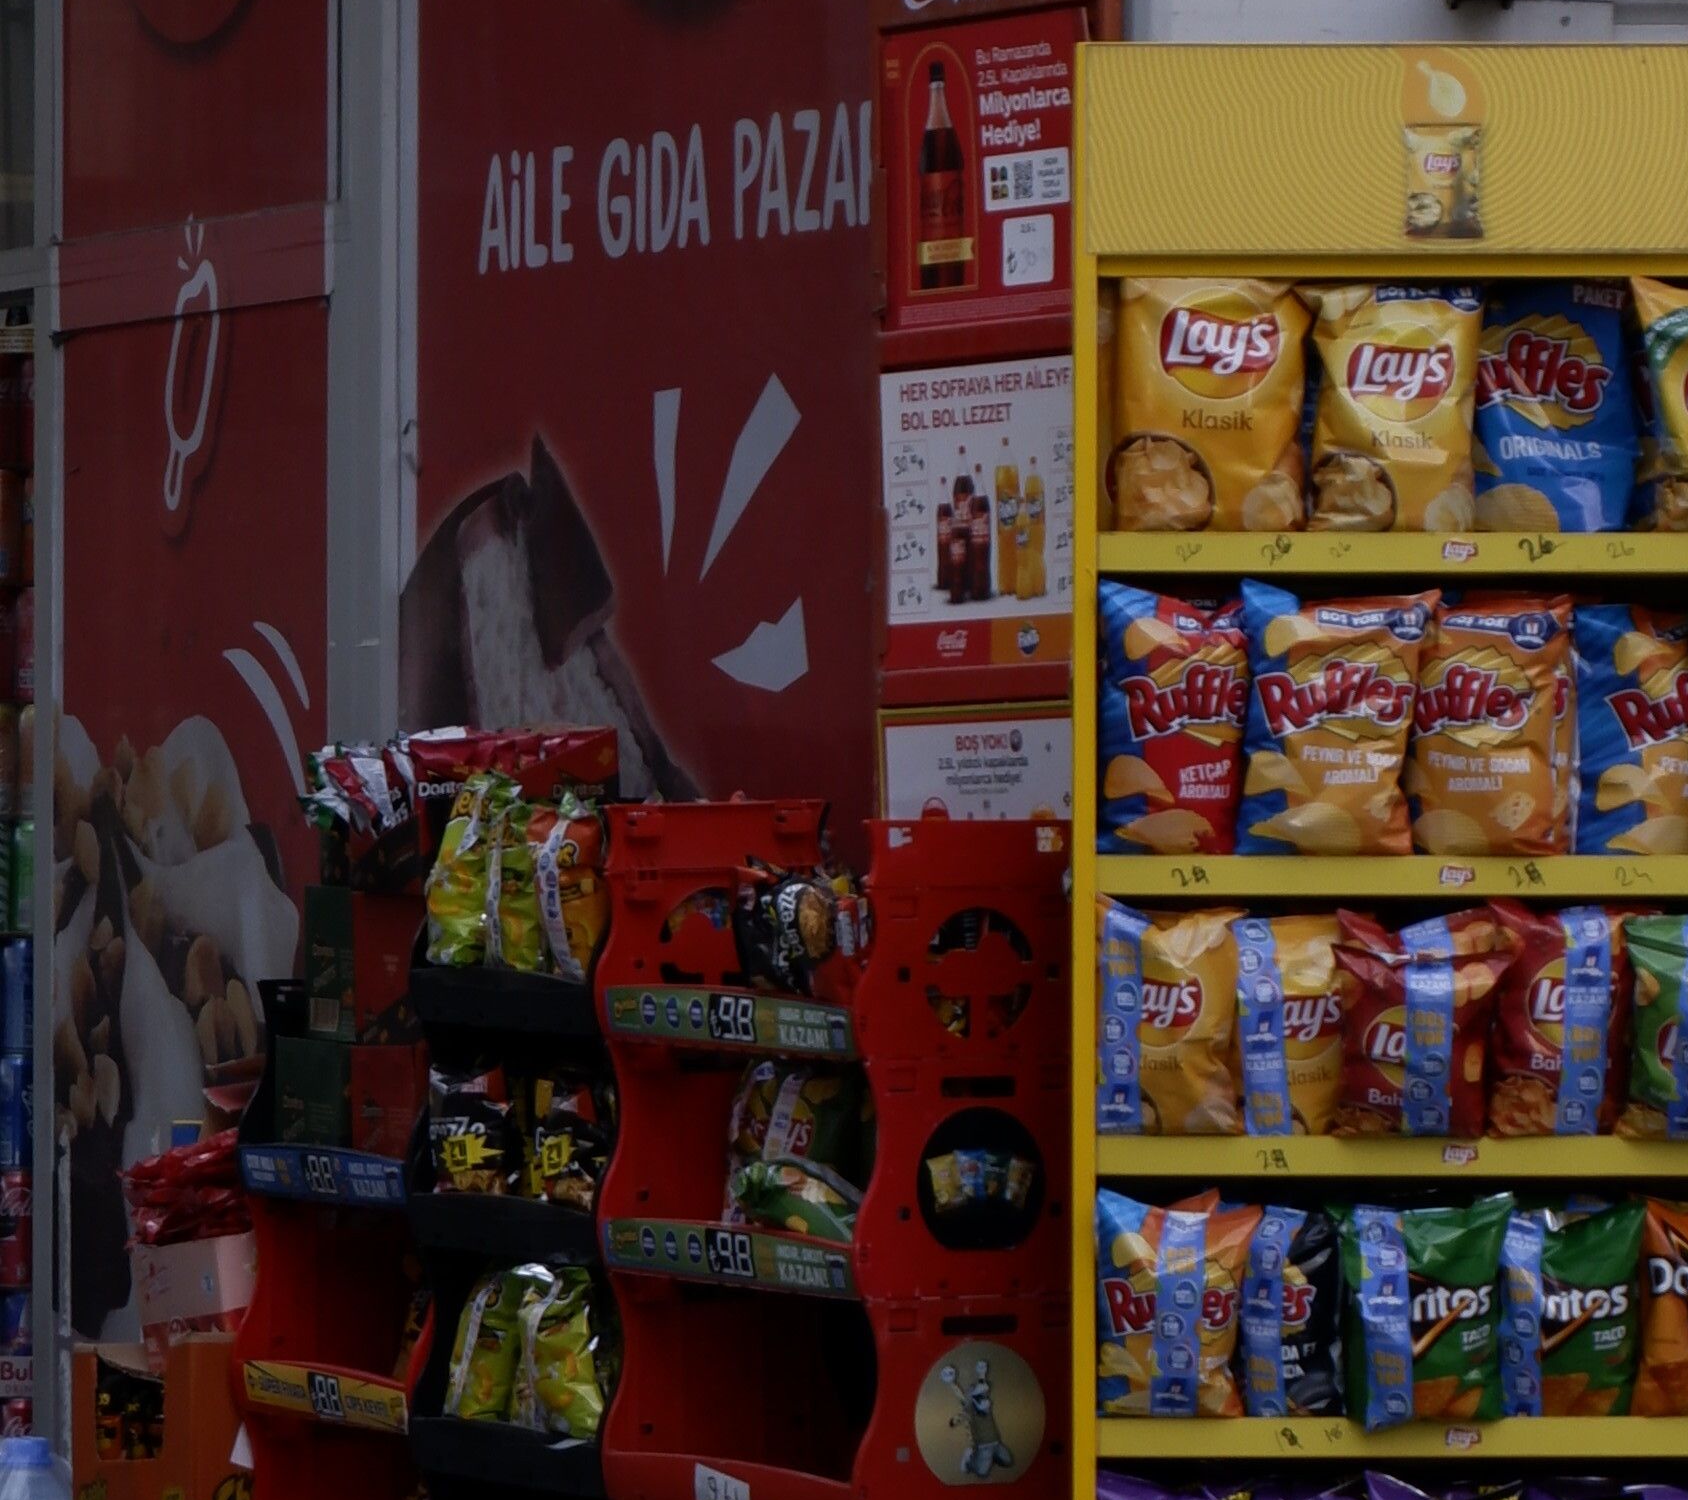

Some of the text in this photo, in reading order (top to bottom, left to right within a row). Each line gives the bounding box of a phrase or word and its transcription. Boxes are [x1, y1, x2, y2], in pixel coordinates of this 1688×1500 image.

[978, 86, 1072, 118] Milyonlarca
[980, 117, 1043, 147] Hediye!
[598, 122, 711, 258] GIDA
[1164, 308, 1280, 376] Lay's
[899, 382, 928, 403] HER
[930, 375, 993, 401] SOFRAYA
[994, 372, 1023, 394] HER
[1348, 342, 1455, 402] Lay's
[900, 402, 1013, 432] BOL BOL LEZZET
[1181, 408, 1254, 431] Klasik
[1369, 429, 1436, 450] Klasik
[1120, 662, 1250, 742] Ruffle
[1253, 660, 1416, 740] Ruffles
[1140, 977, 1202, 1018] ay's
[779, 1025, 830, 1050] KAZAN!
[777, 1260, 830, 1286] KAZAN!
